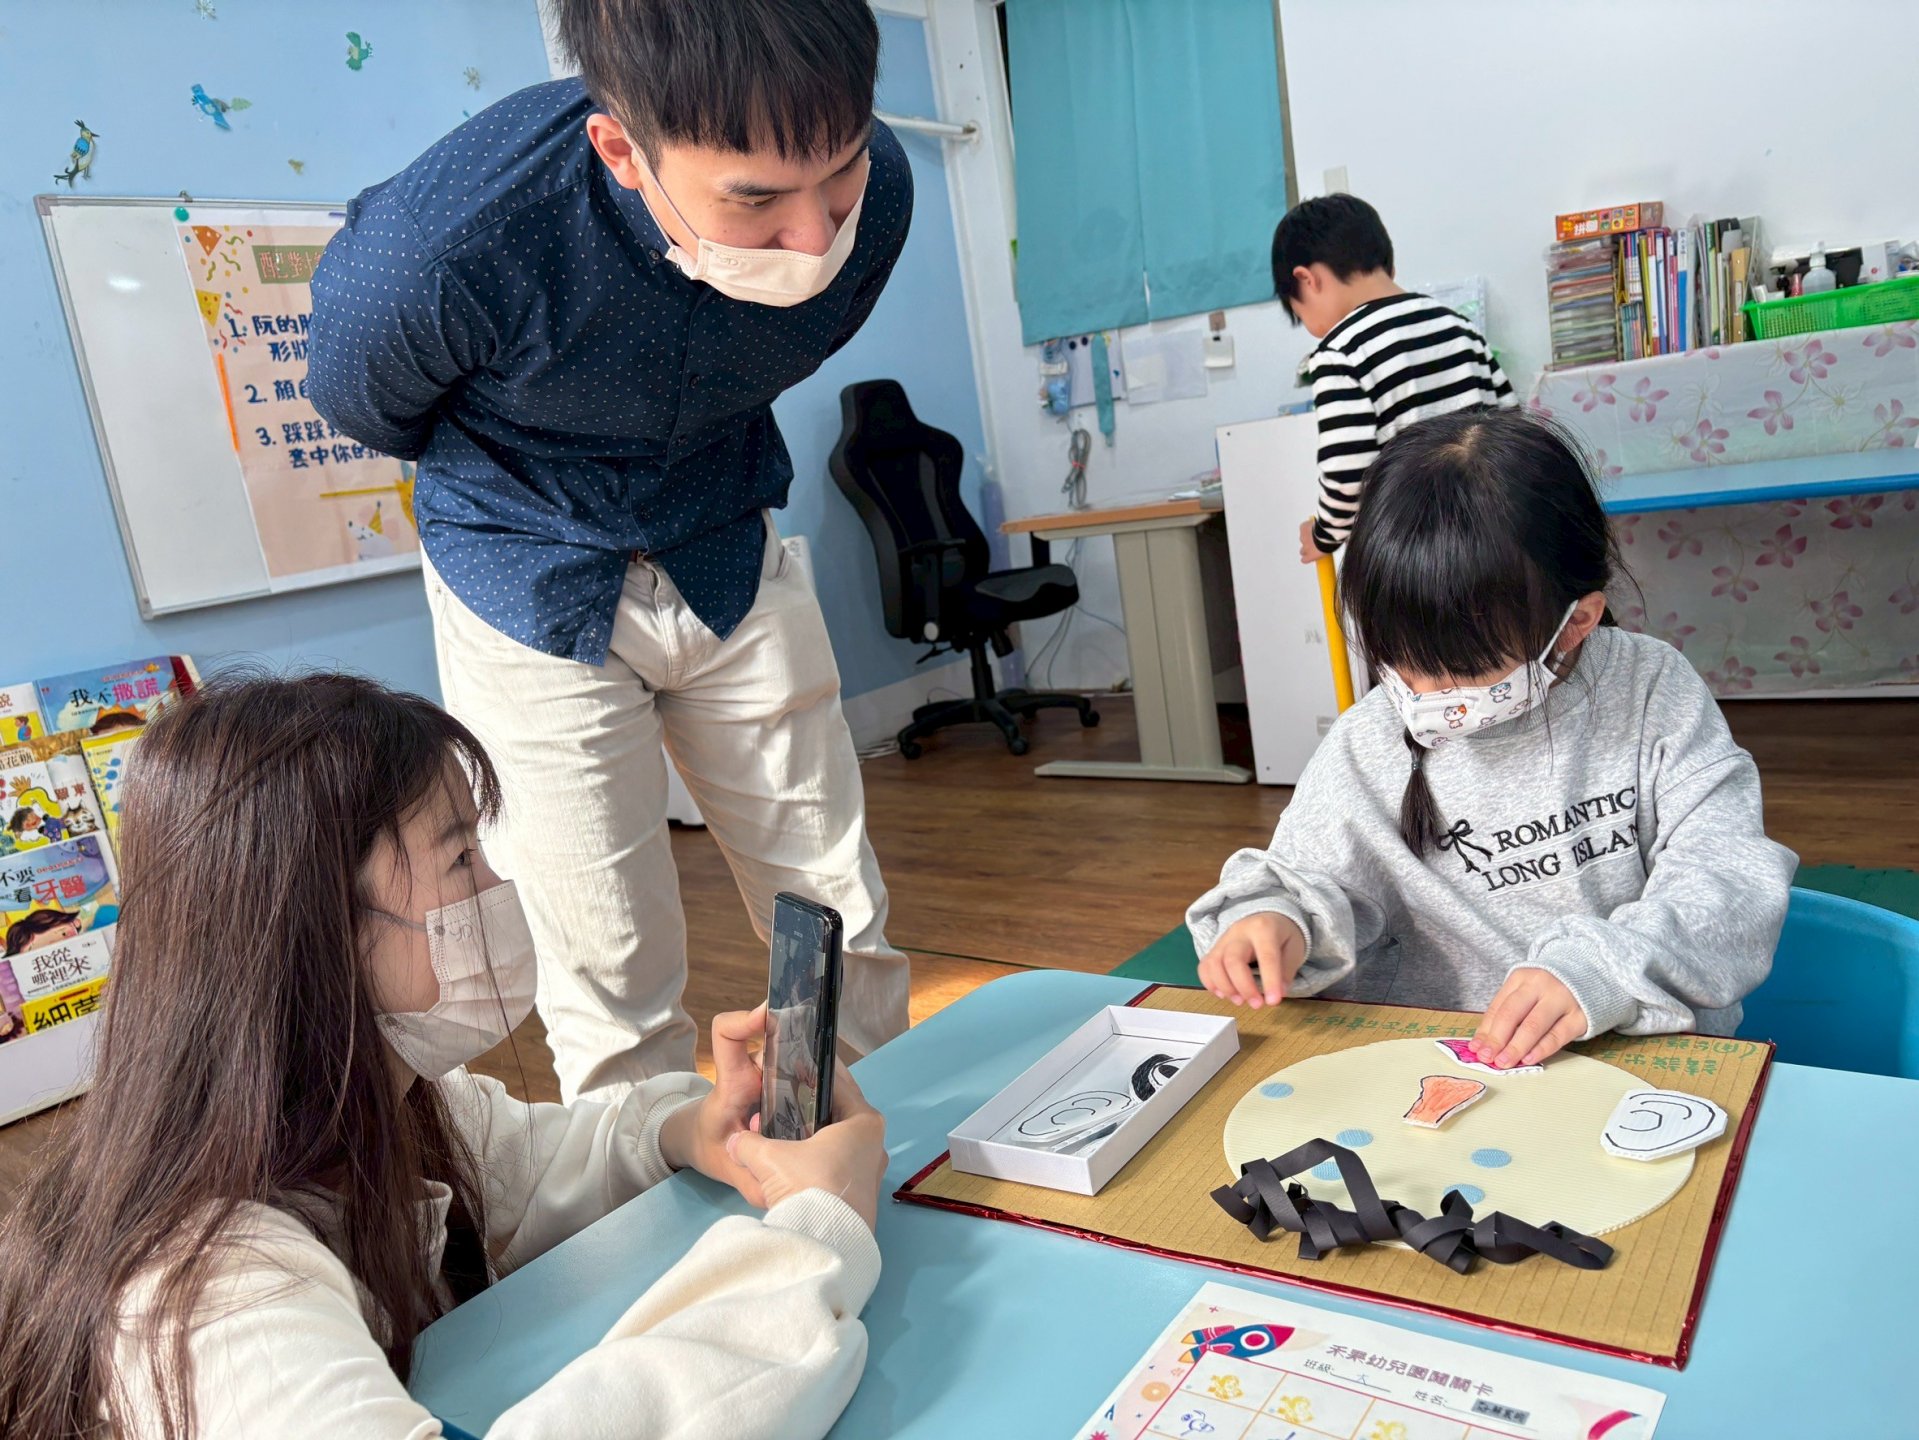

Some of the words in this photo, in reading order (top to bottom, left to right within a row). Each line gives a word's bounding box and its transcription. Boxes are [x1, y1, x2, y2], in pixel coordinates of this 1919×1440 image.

[229, 318, 247, 338] 1.
[244, 384, 268, 404] 2.
[256, 426, 277, 446] 3.
[70, 678, 161, 708] 我不撒謊
[1492, 786, 1637, 853] ROMANTIC
[1481, 852, 1562, 892] LONG
